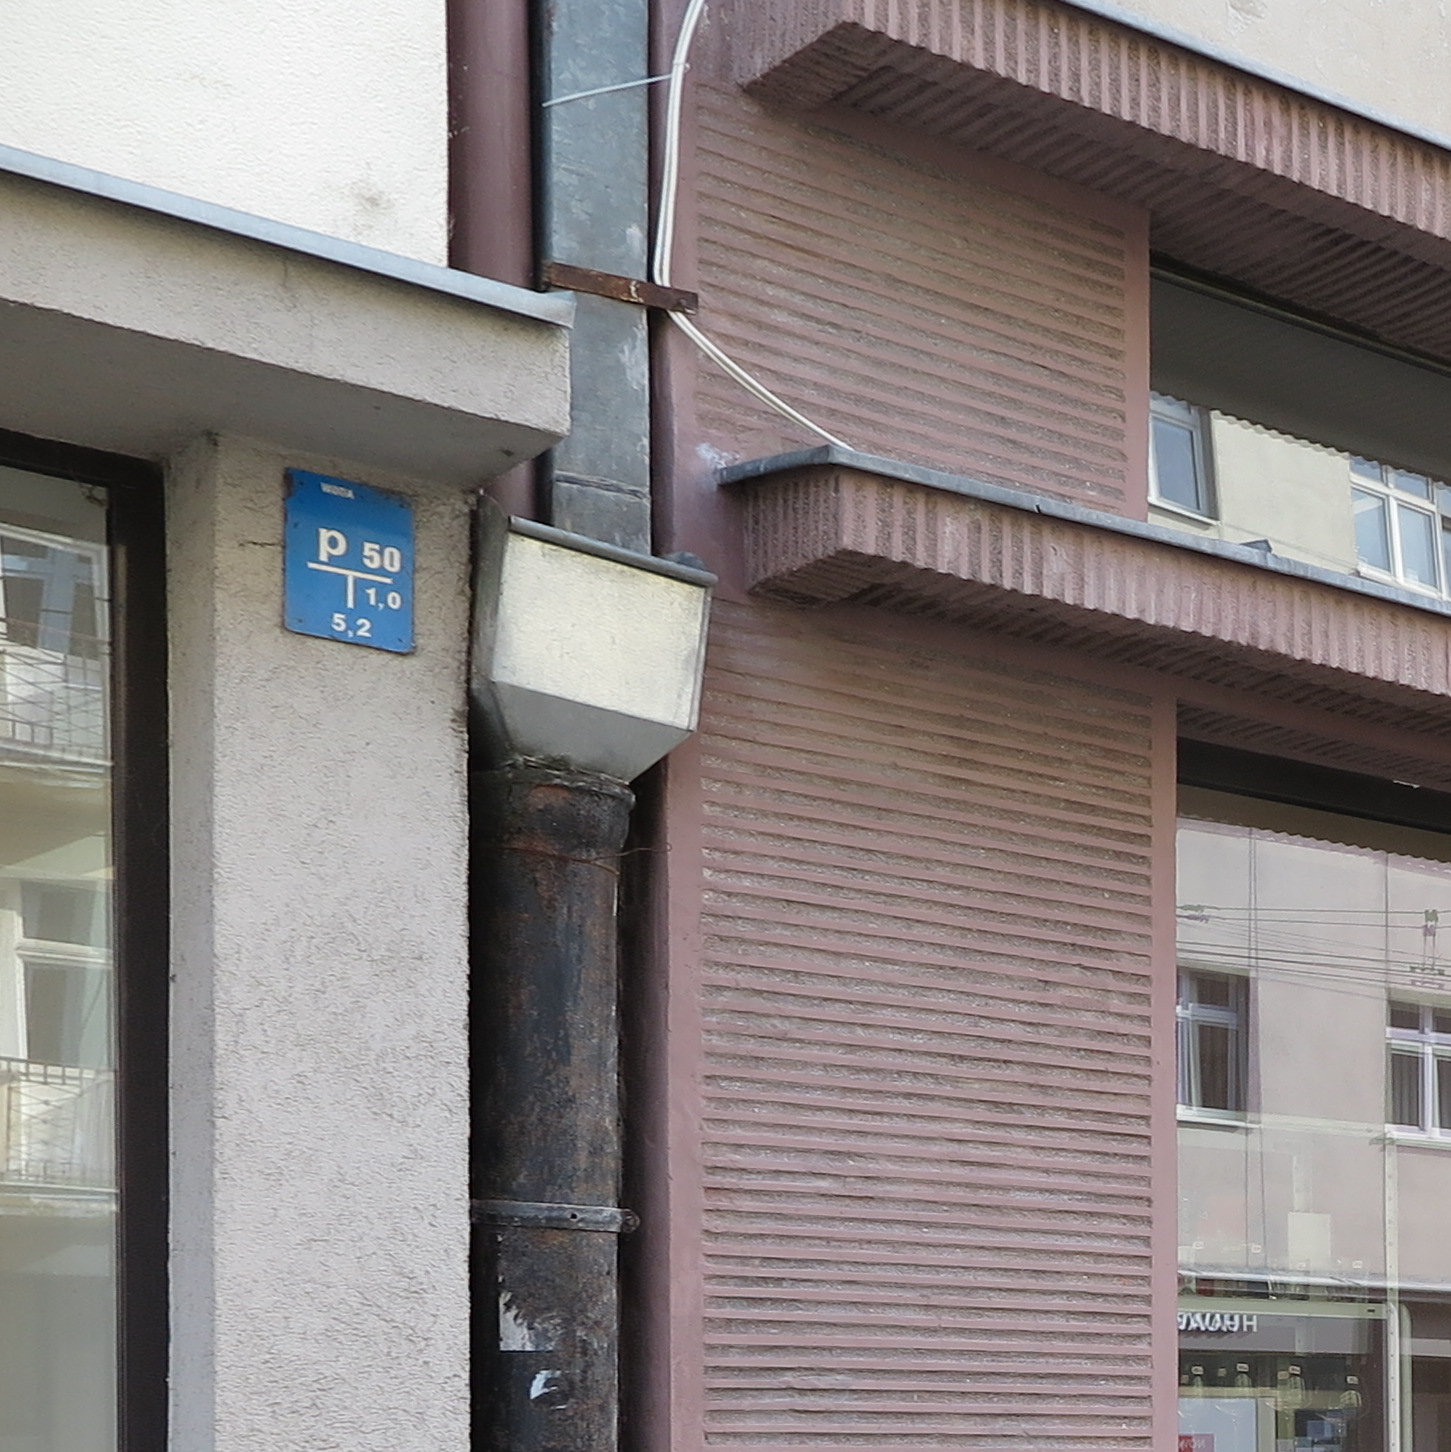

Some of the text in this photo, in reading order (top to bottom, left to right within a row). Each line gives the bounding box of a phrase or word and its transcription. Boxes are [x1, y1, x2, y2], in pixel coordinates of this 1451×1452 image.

[362, 541, 401, 572] 50
[365, 587, 401, 610] 1,0
[331, 612, 372, 638] 5,2
